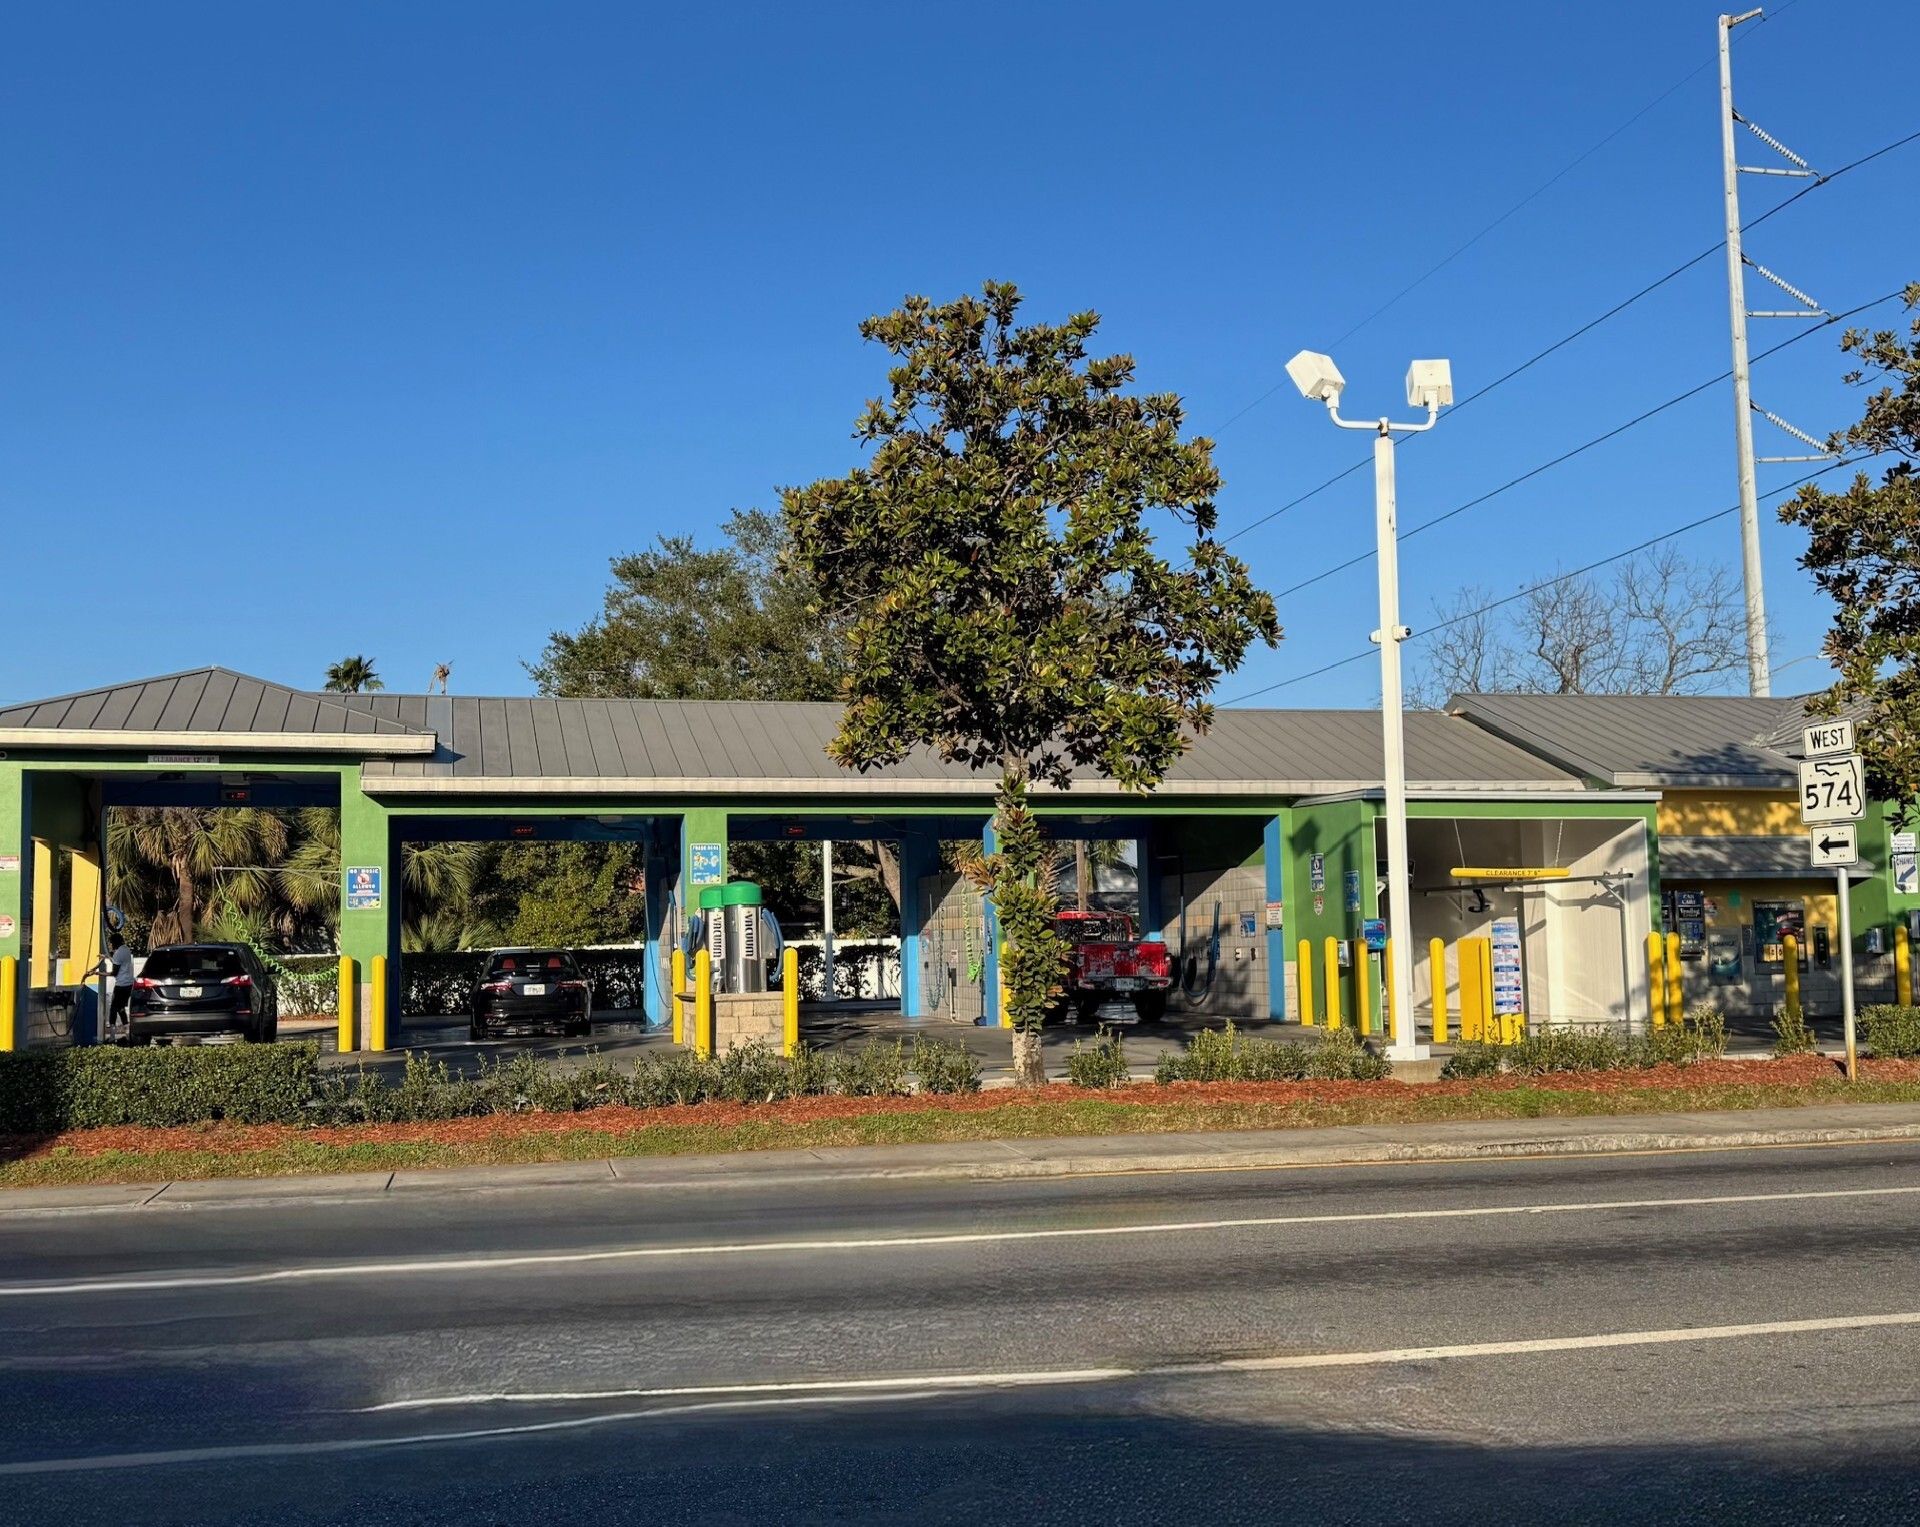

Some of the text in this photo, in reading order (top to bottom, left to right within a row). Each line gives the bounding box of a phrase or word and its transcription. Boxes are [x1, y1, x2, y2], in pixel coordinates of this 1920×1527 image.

[1810, 727, 1845, 749] WEST
[1806, 780, 1852, 809] 574
[713, 916, 722, 957] VACUUM
[744, 914, 754, 957] VACUUM
